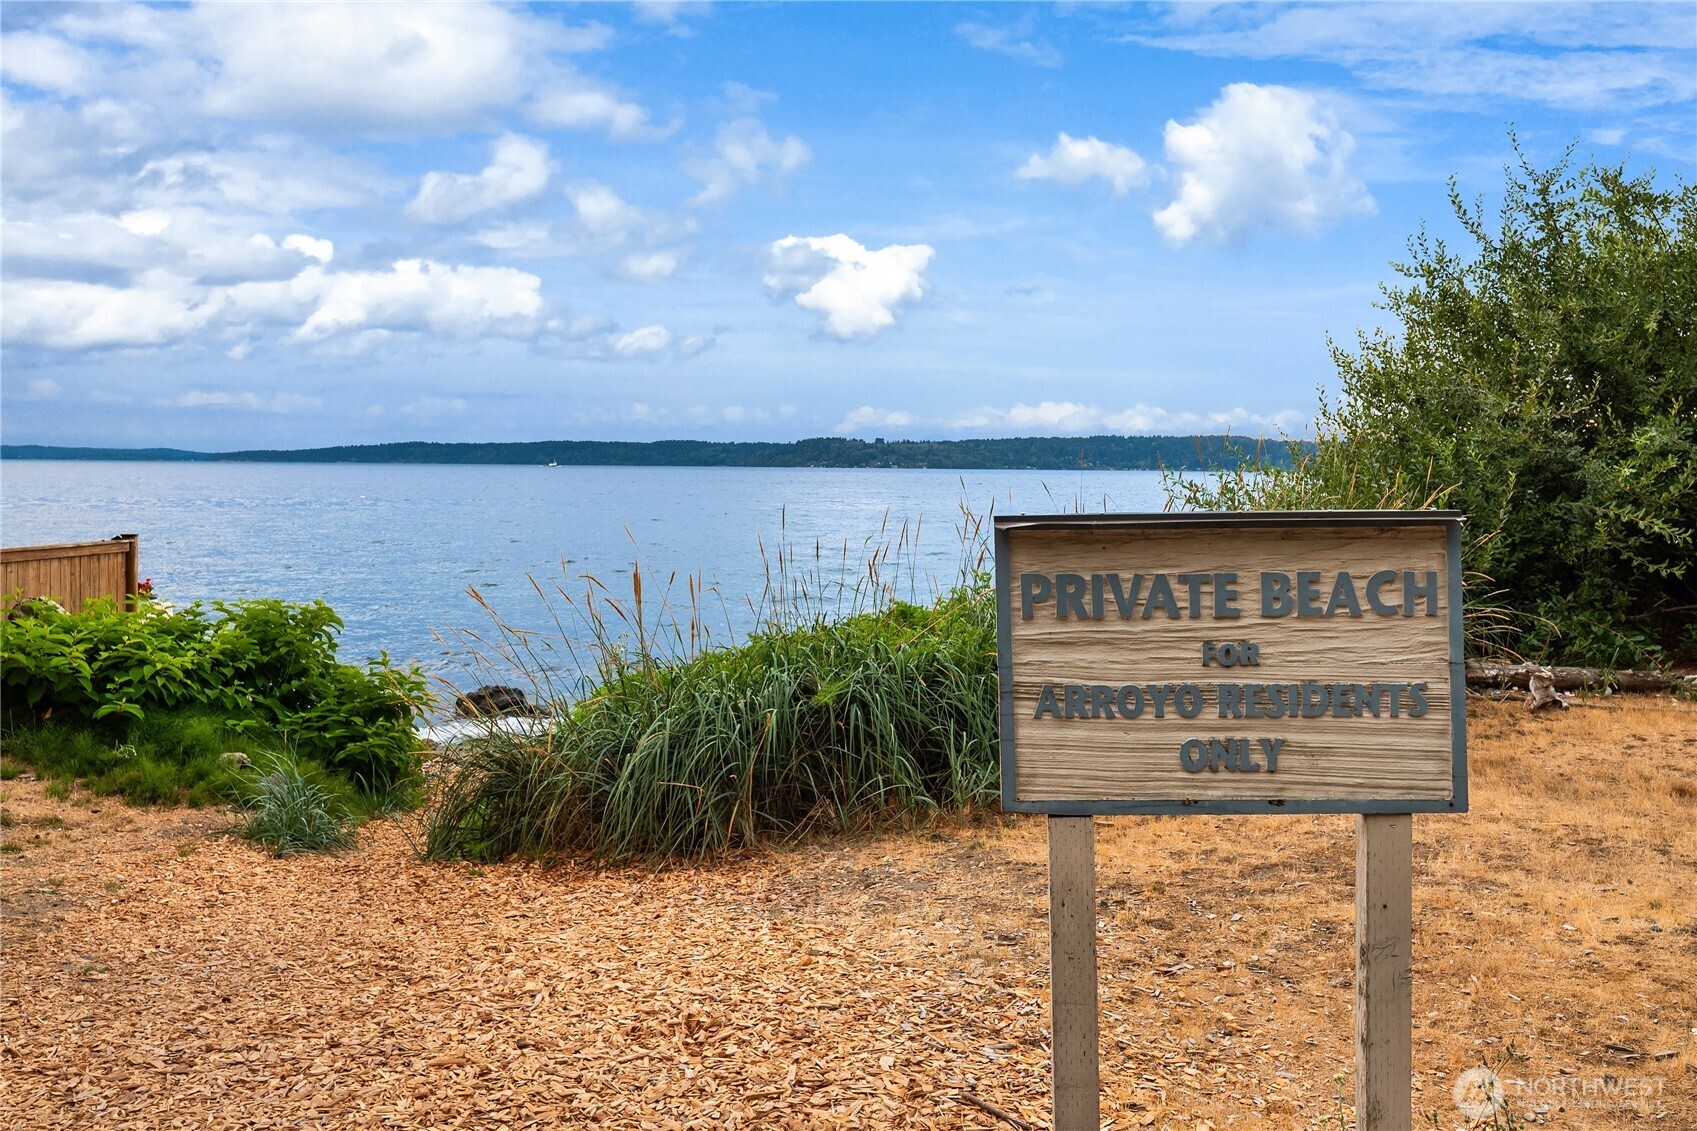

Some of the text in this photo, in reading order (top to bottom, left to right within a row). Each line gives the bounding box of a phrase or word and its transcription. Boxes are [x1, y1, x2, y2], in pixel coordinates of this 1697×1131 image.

[1020, 570, 1438, 620] PRIVATE BEACH
[1202, 641, 1260, 667] FOR
[1033, 682, 1428, 719] ARROYO RESIDENTS
[1180, 737, 1284, 773] ONLY
